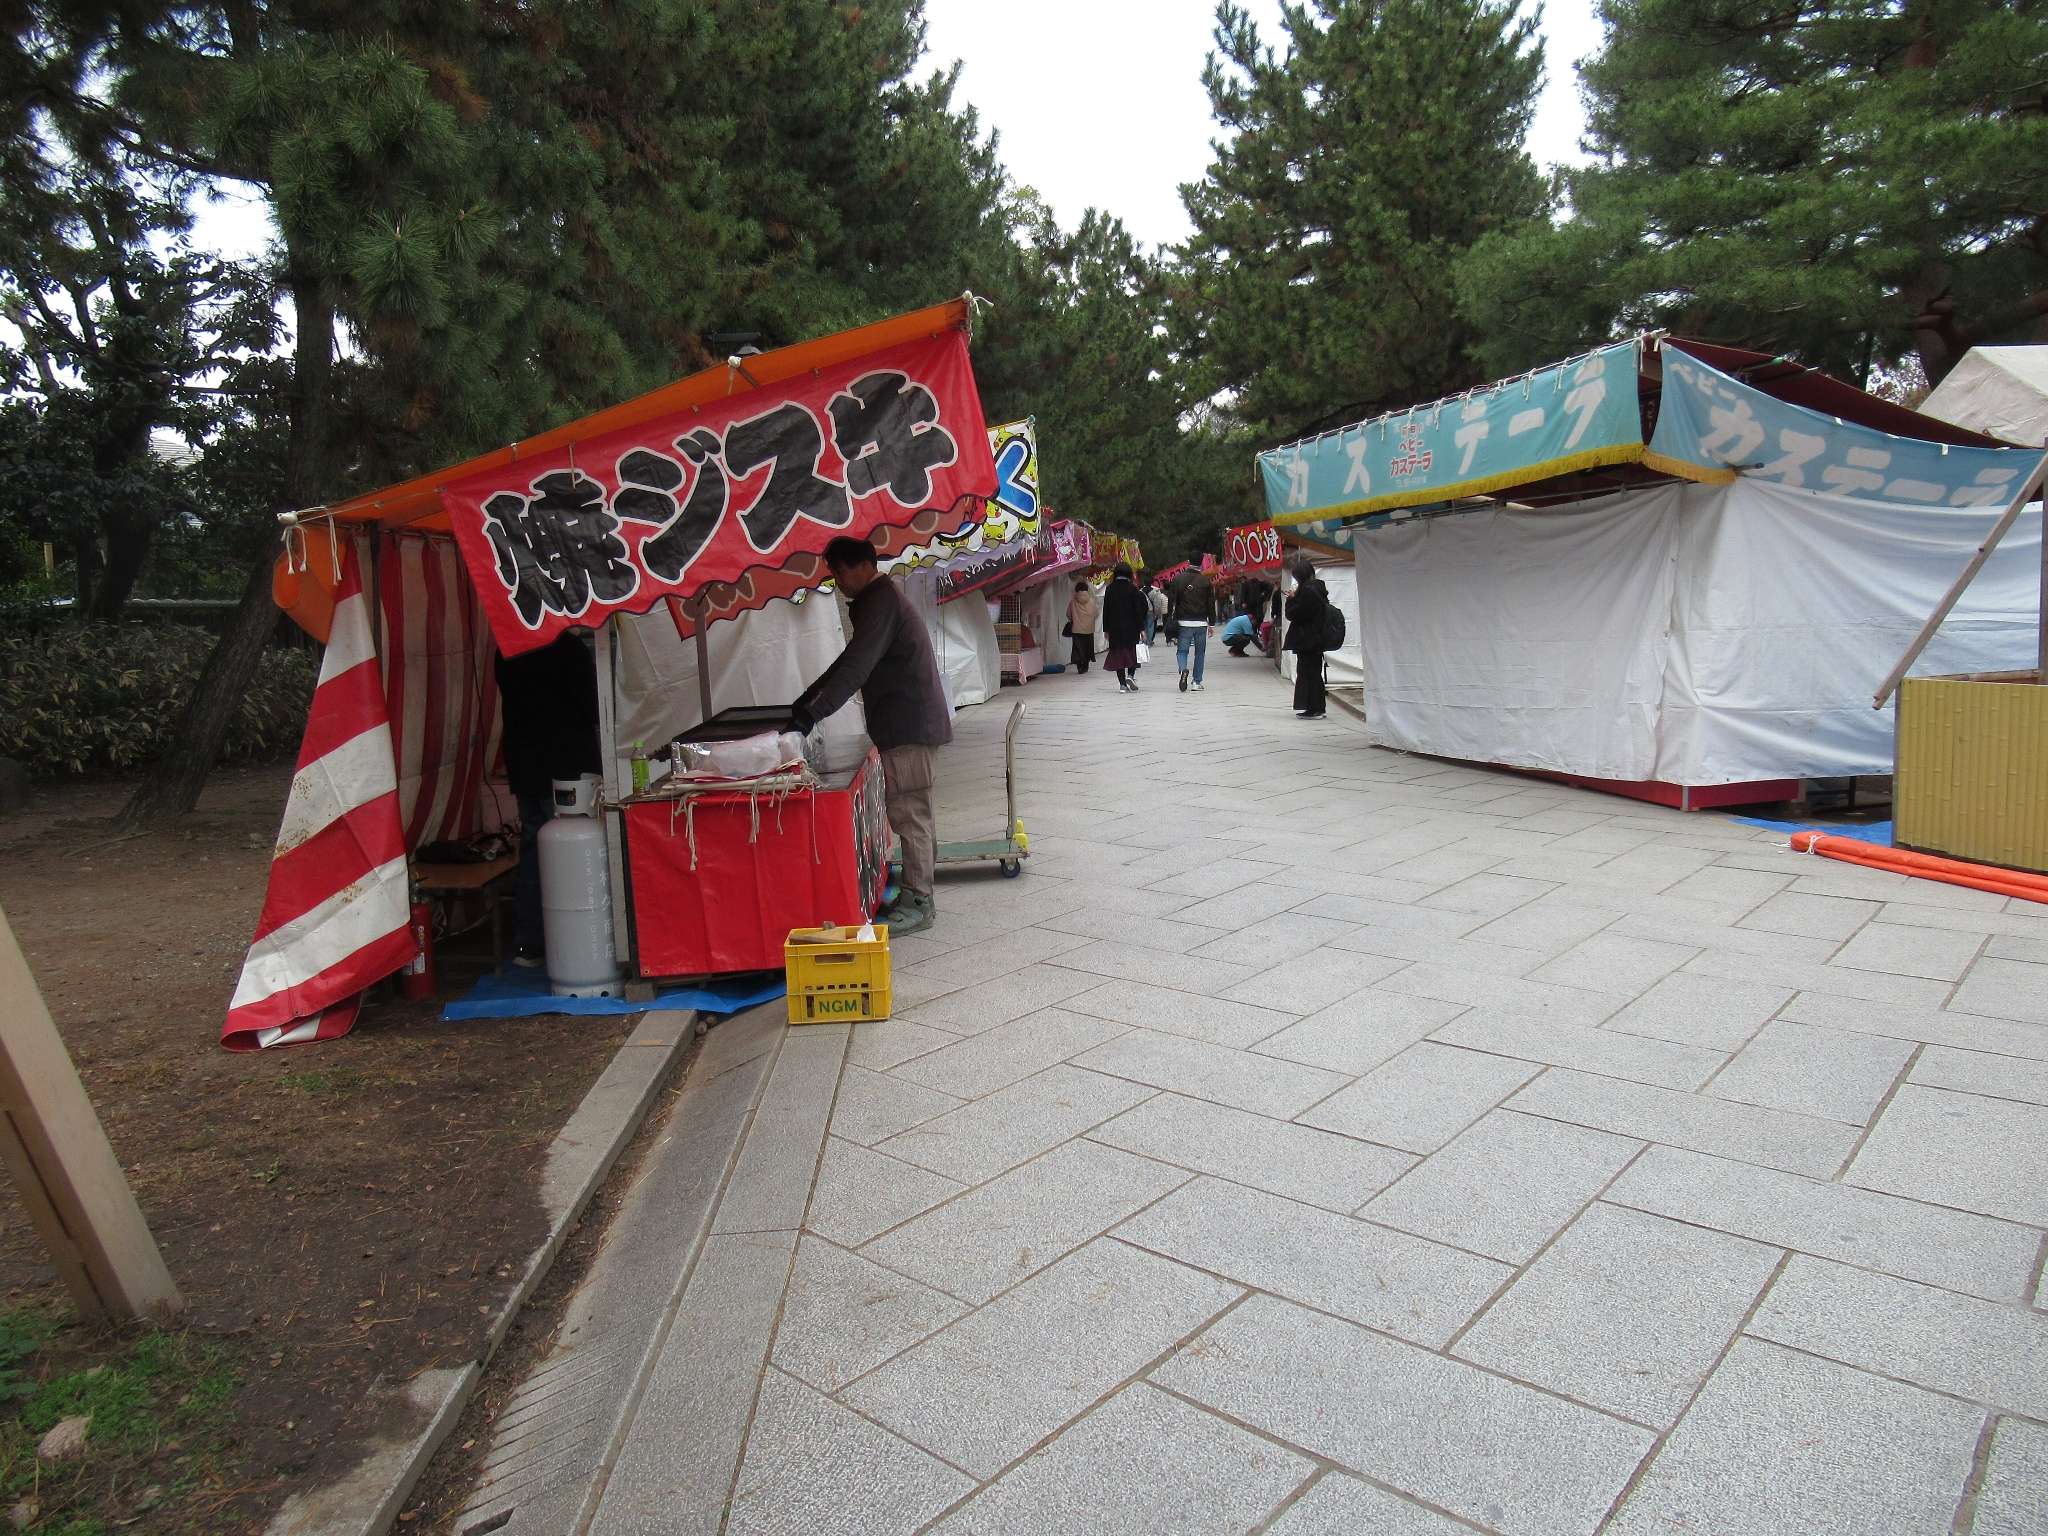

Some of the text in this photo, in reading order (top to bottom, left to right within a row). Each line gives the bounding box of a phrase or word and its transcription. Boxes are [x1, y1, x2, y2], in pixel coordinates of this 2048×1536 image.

[1391, 450, 1432, 476] カステーラ
[818, 999, 858, 1014] NGM
